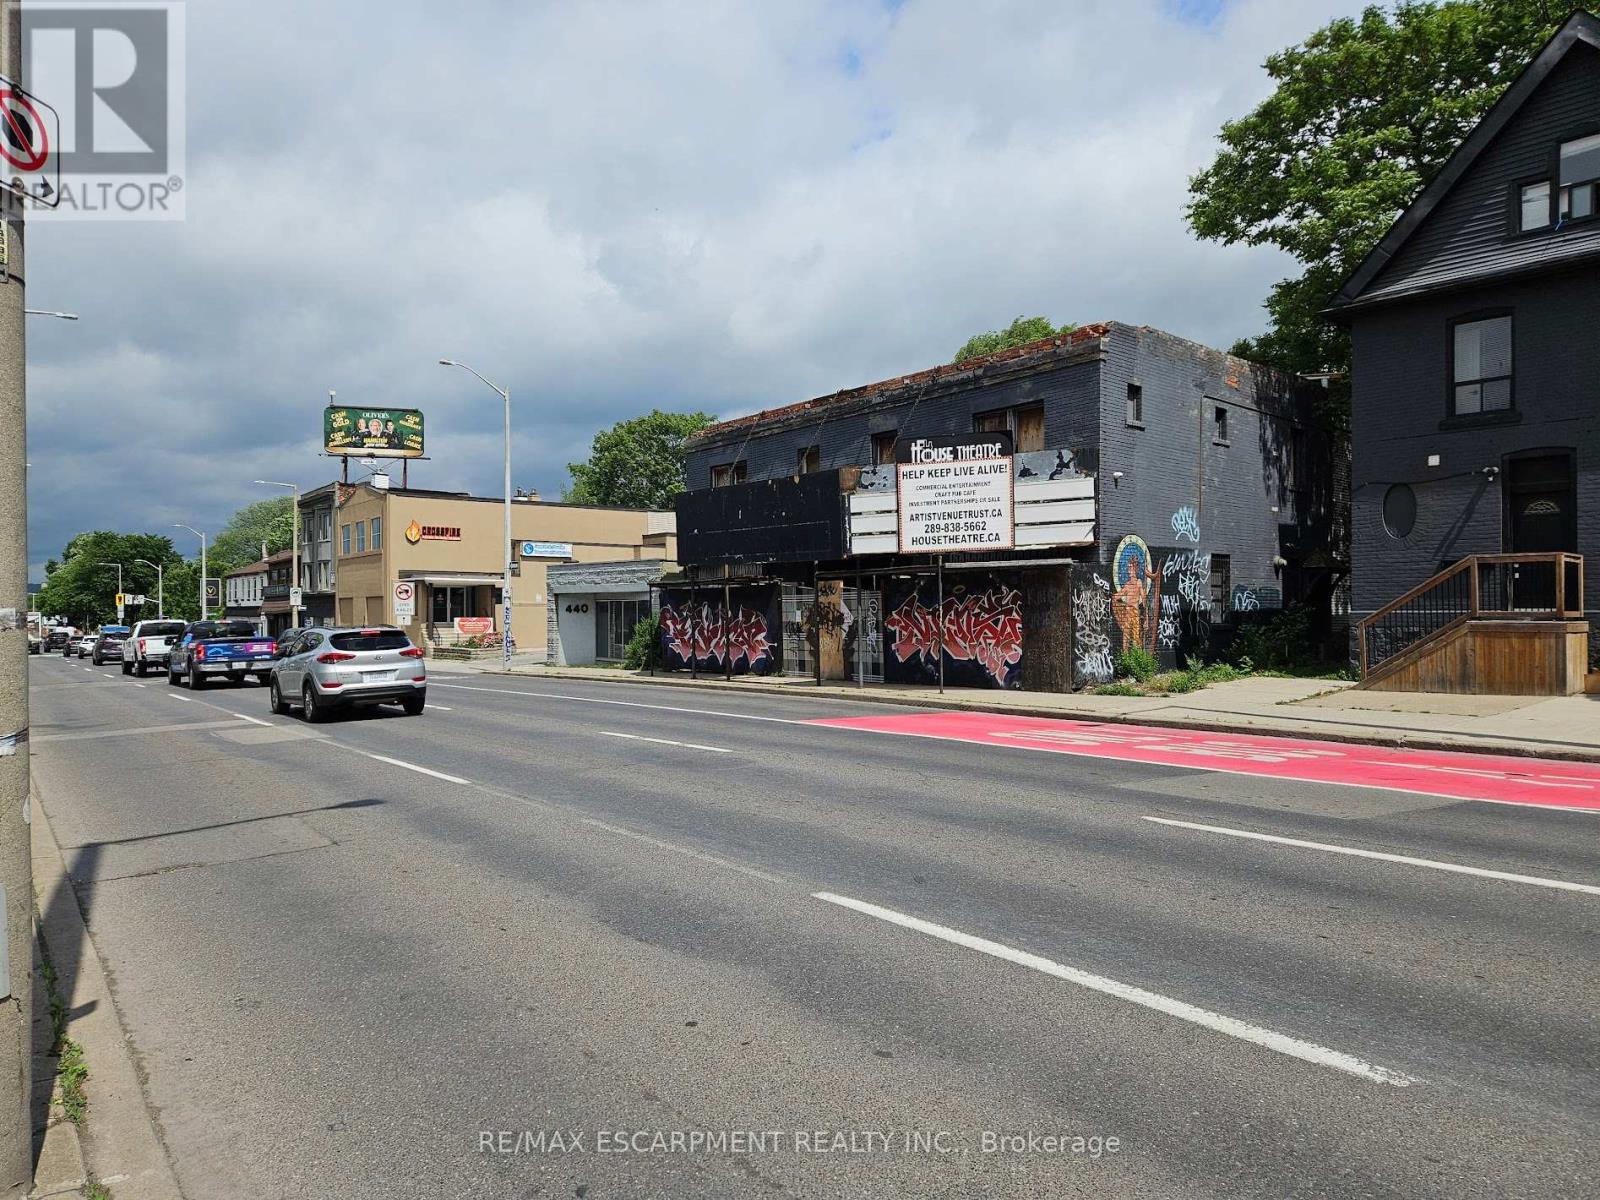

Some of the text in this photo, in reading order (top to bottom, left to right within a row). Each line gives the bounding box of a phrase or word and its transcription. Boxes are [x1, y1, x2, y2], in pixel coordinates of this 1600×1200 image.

[956, 443, 1002, 461] THEATRE
[902, 463, 1008, 480] HELP KEEP LIVE ALIVE!
[916, 481, 991, 491] COMMERCIAL ENTERTAINMENT
[908, 499, 940, 507] INVESTMENT
[940, 498, 978, 506] PARTNERSHIPS
[909, 508, 1003, 522] ARTISTVENUETRUST.CA
[924, 520, 987, 534] 289-838-5662
[911, 532, 1001, 546] HOUSETHEATRE.CA
[565, 604, 589, 614] 440
